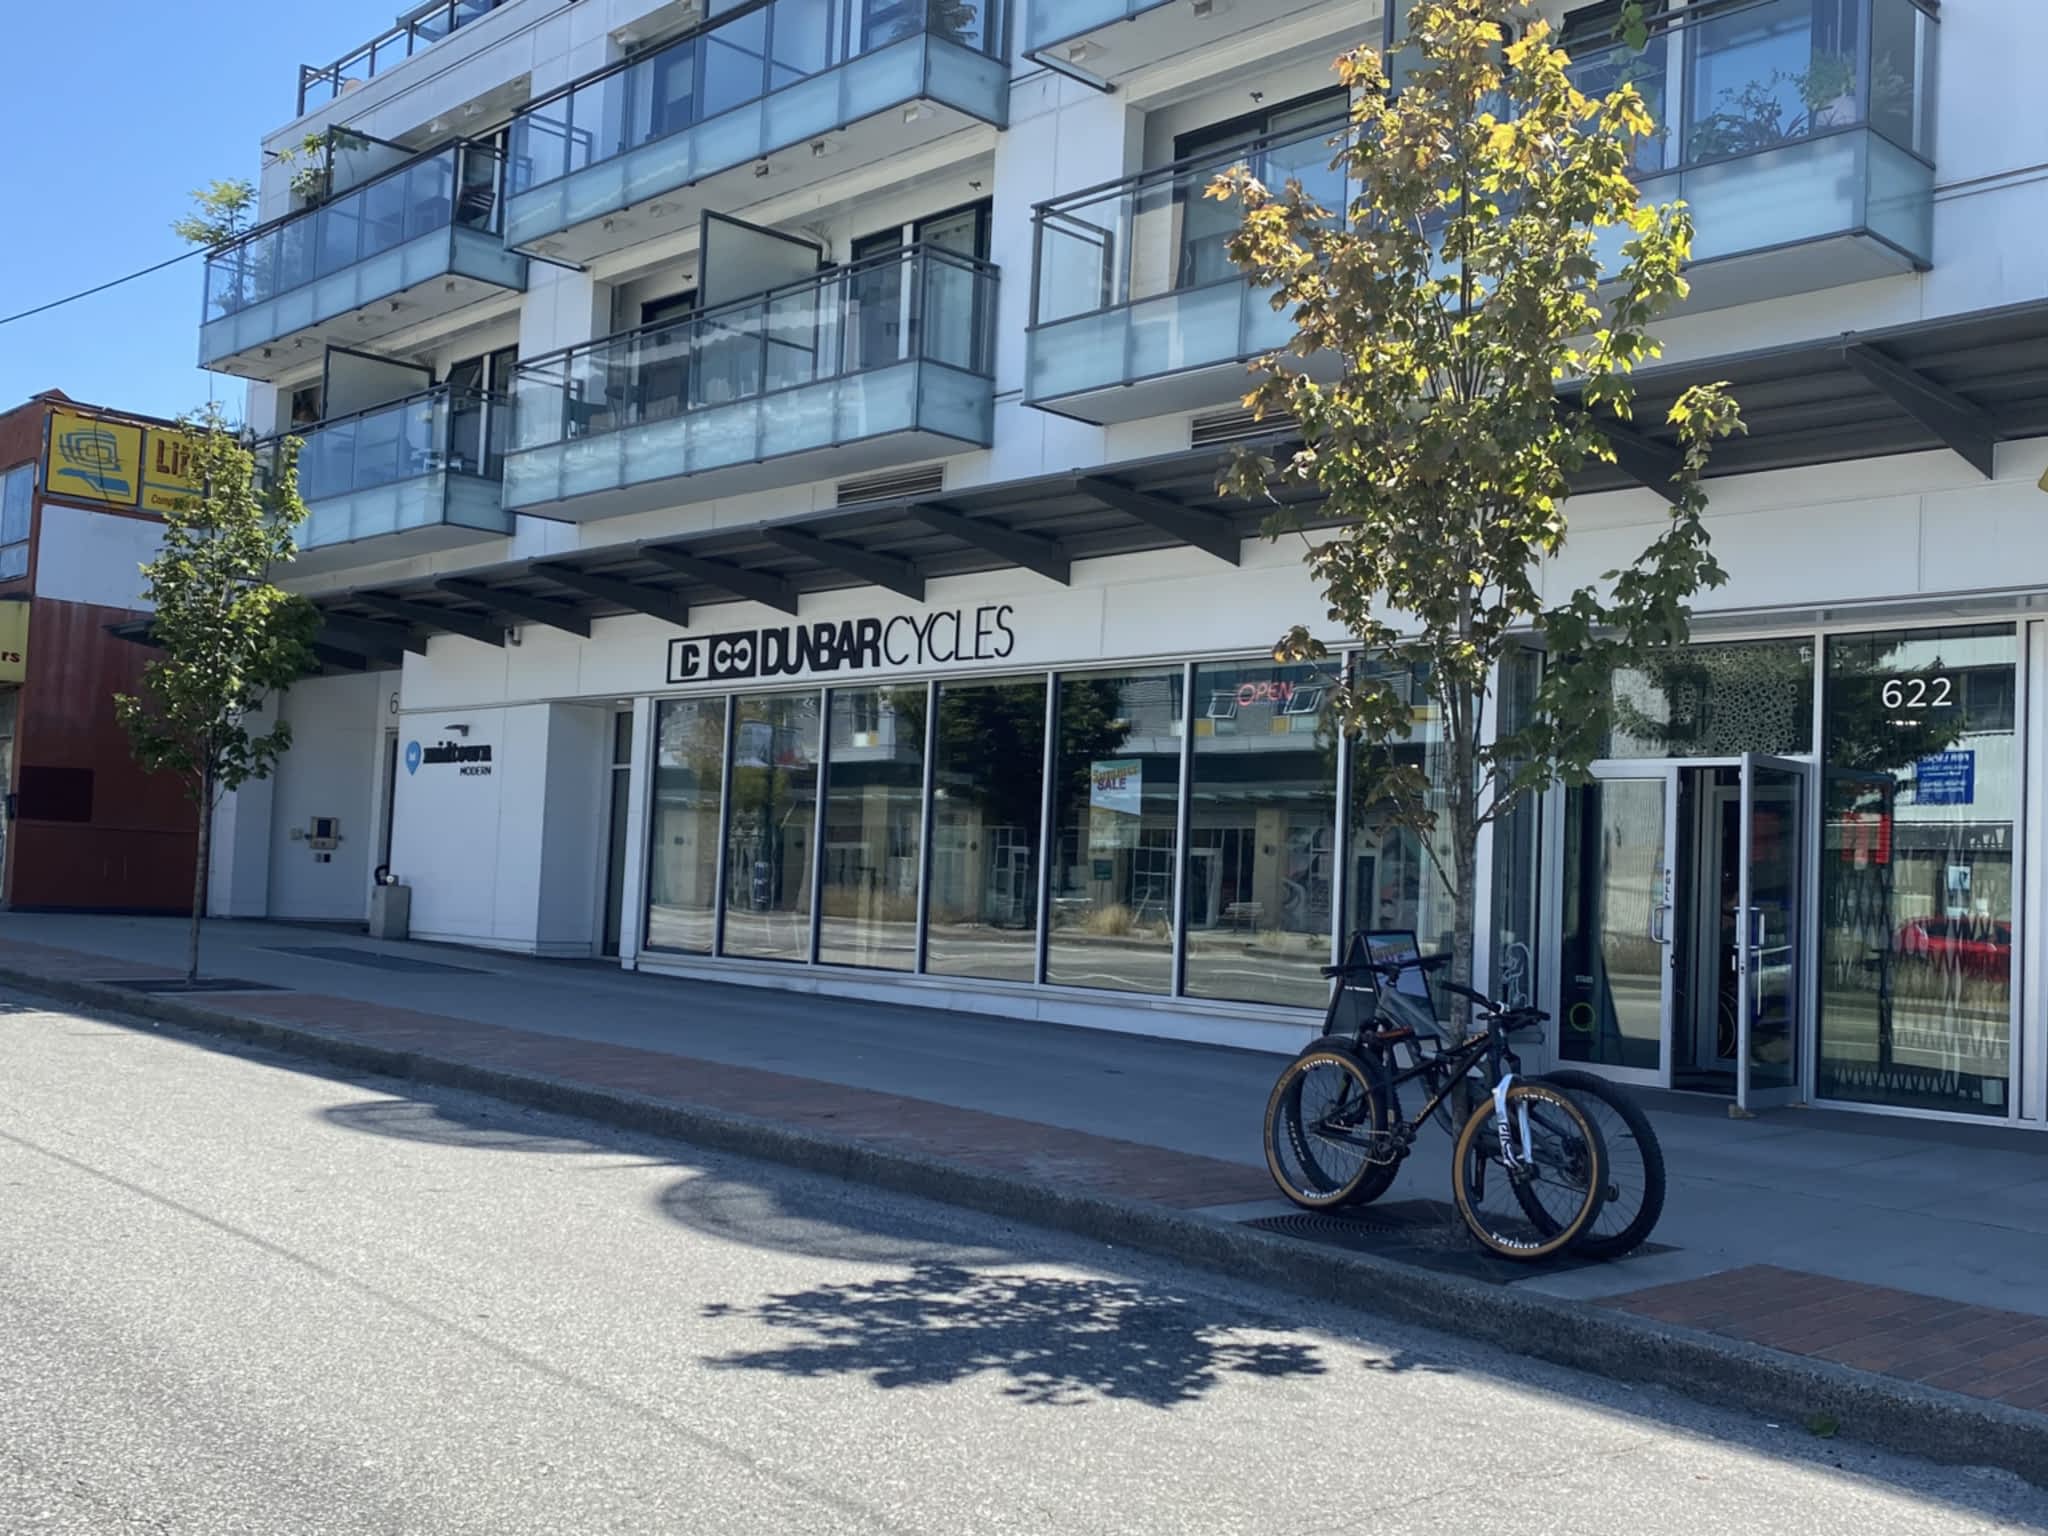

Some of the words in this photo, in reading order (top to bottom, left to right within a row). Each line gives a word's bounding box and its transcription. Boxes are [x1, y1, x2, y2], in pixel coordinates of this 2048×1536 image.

[1237, 681, 1296, 706] OPEN
[1881, 677, 1953, 708] 622
[459, 766, 492, 776] MODERN
[1097, 777, 1127, 791] SALE
